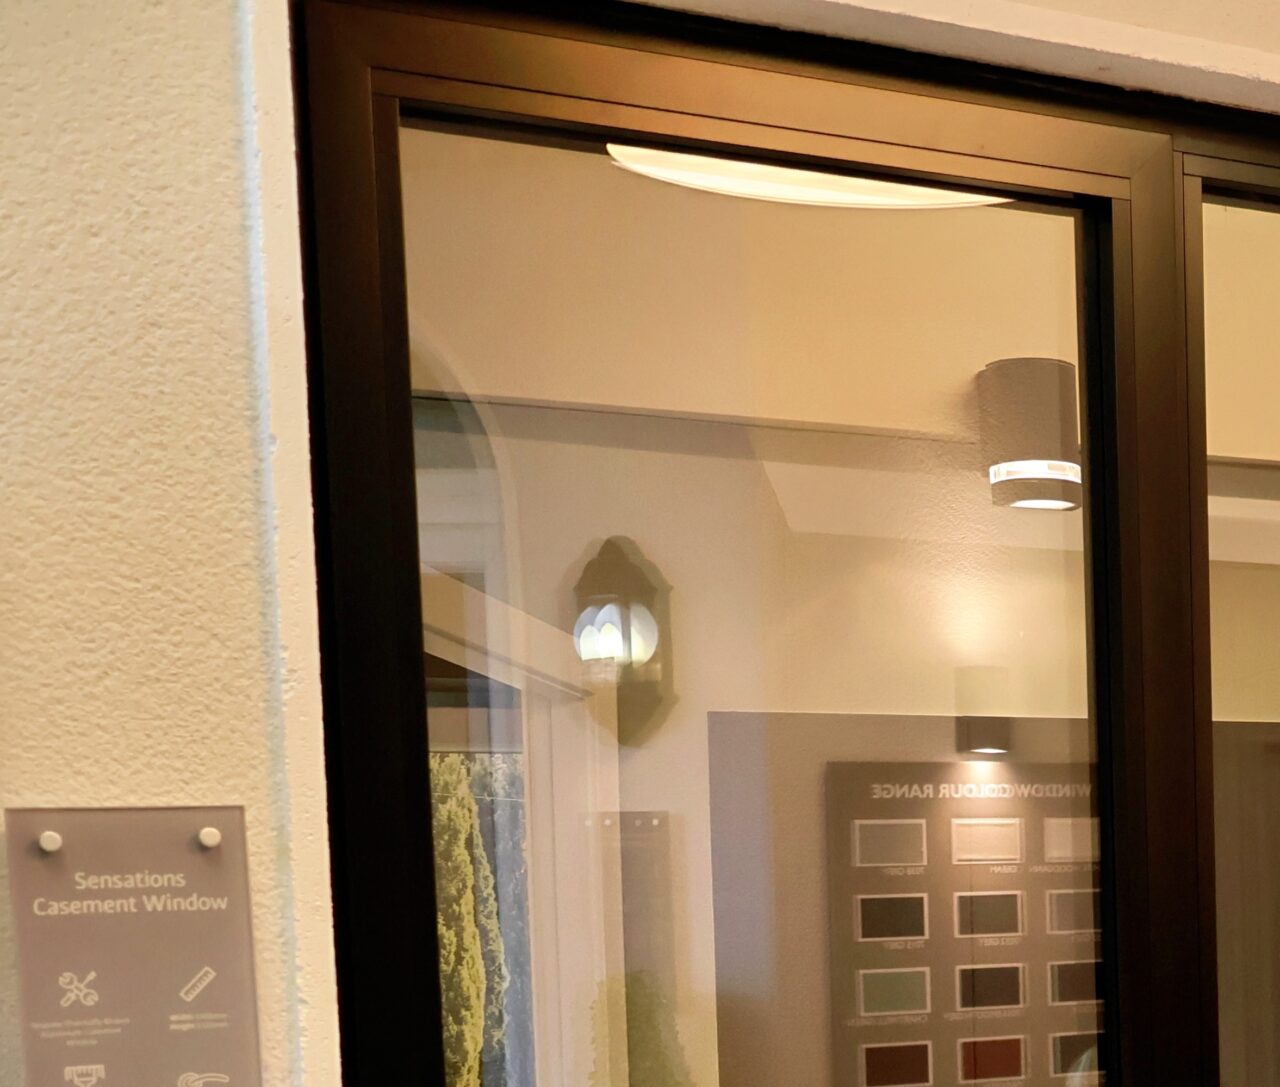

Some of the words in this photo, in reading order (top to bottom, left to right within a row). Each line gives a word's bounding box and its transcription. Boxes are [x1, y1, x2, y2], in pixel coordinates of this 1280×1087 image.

[74, 870, 186, 890] Sensations
[33, 896, 138, 916] Casement
[143, 893, 229, 912] Window
